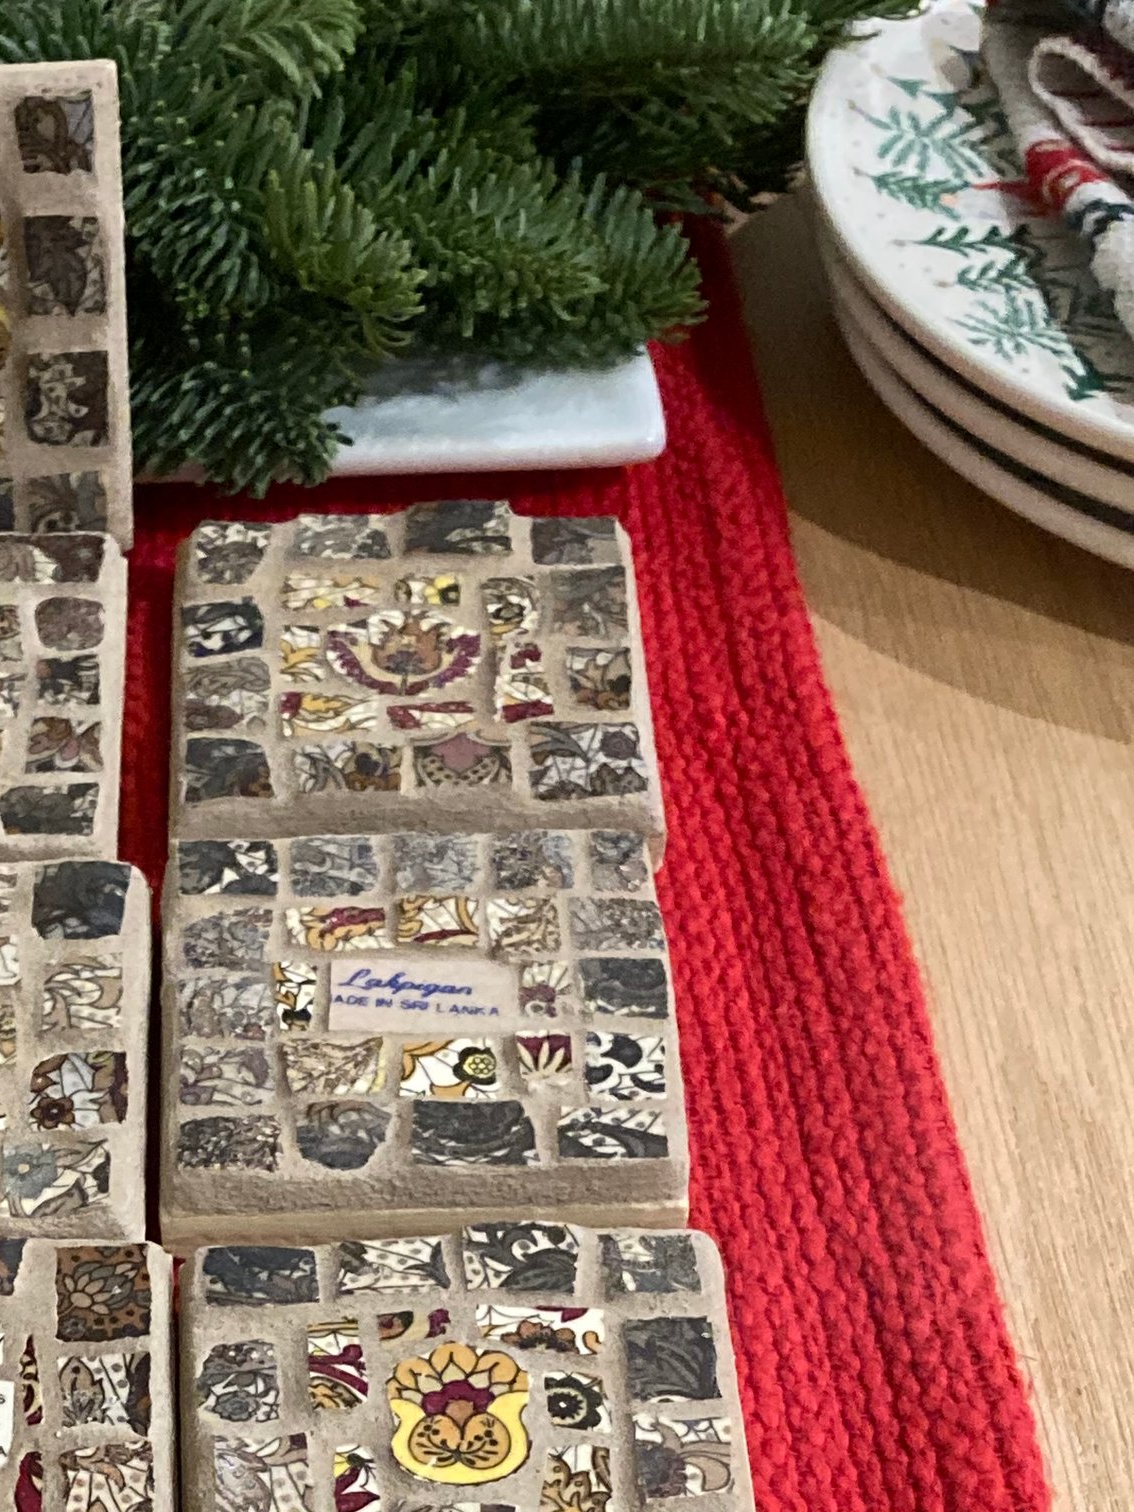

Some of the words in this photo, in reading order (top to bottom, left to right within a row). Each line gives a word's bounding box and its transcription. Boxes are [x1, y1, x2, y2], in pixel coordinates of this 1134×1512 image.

[332, 994, 369, 1008] ADE
[375, 997, 393, 1008] IN
[400, 999, 429, 1010] SRI
[436, 1002, 500, 1016] LANKA
